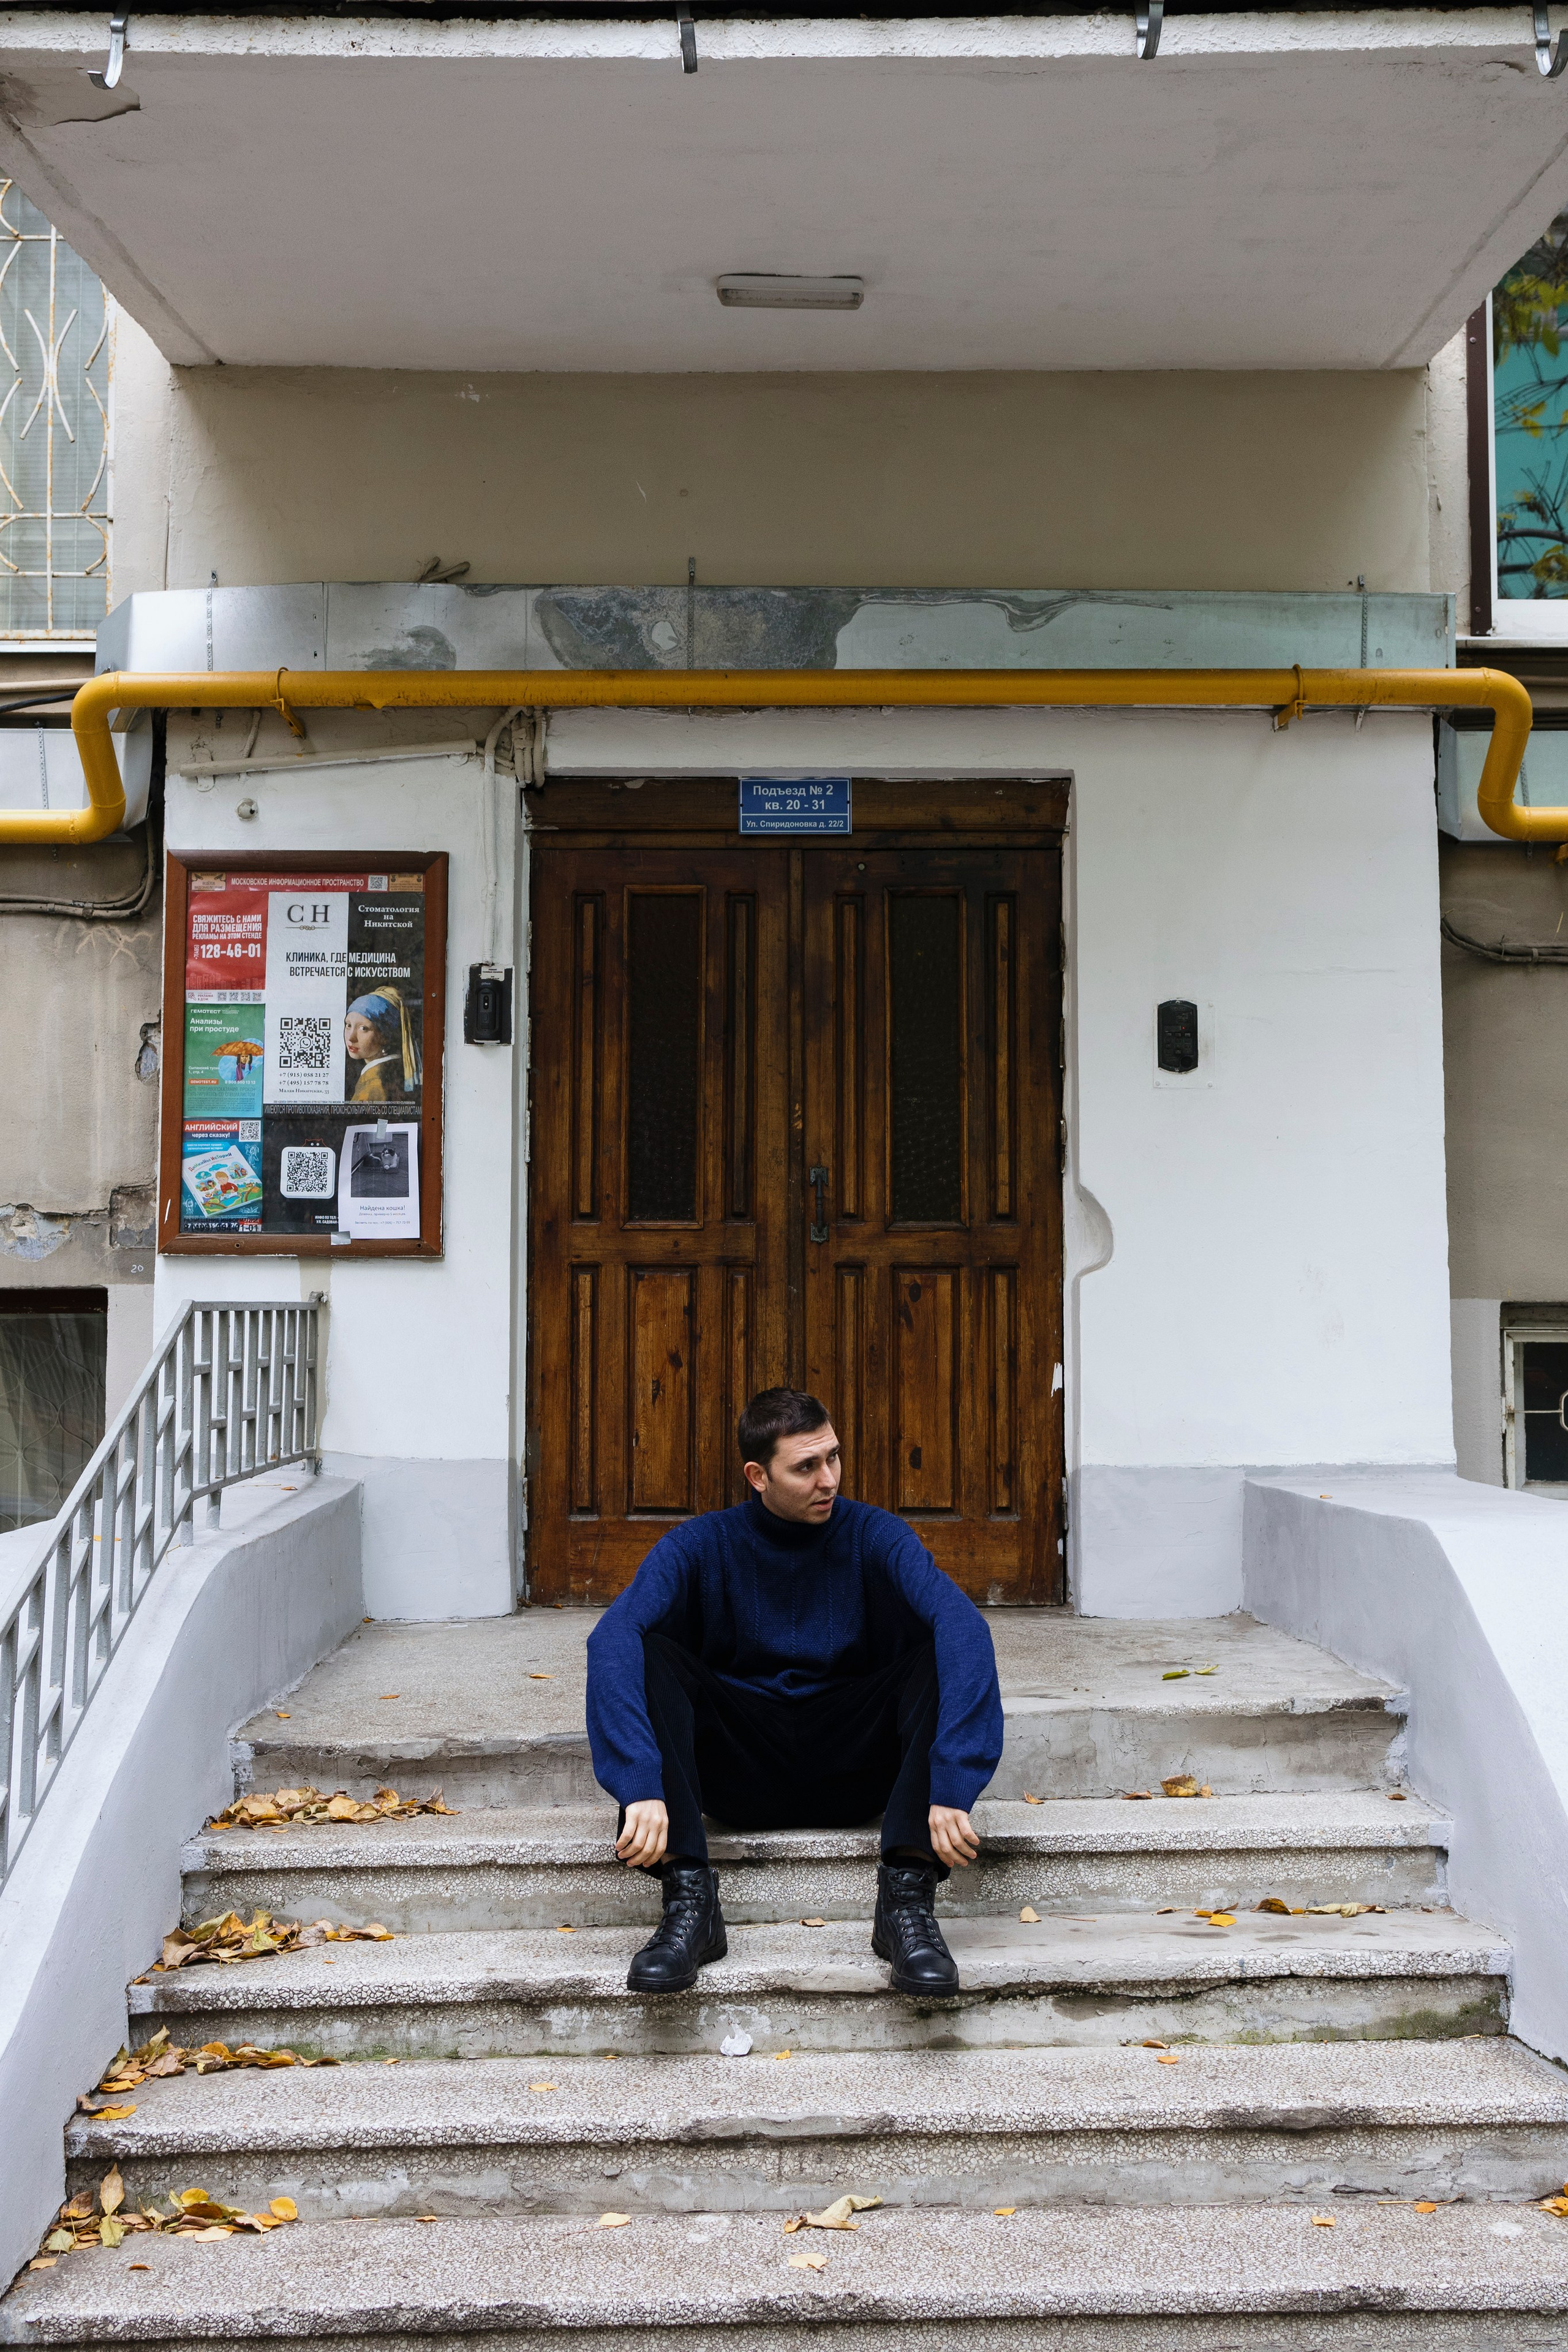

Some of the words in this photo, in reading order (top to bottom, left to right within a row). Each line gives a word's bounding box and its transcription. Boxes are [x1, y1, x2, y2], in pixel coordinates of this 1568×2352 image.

[753, 785, 806, 797] Подъезд
[809, 786, 823, 795] №
[826, 785, 833, 795] 2
[765, 801, 783, 810] кв.
[786, 800, 800, 810] 20
[812, 800, 825, 810] 31
[760, 820, 817, 829] Спиридоновка
[193, 915, 235, 923] СВЯЖИТЕСЬ
[236, 915, 241, 923] С
[243, 914, 262, 923] НАМИ
[192, 923, 208, 933] ДЛЯ
[210, 923, 262, 933] РАЗМЕЩЕНИЯ
[201, 943, 261, 958] 128-46-01
[286, 952, 328, 963] КЛИНИКА,
[330, 952, 346, 963] ГДЕ
[349, 953, 396, 964] МЕДИЦИНА
[290, 967, 345, 977] ВСТРЕЧАЕТСЯ
[348, 967, 353, 977] С
[355, 967, 410, 978] ИСКУССТВОМ
[264, 1105, 285, 1114] ИМЕЮТСЯ
[286, 1105, 330, 1115] ПРОТИВОПОКАЗАНИЯ,
[331, 1104, 381, 1114] ПРОКОНСУЛЬТИРУЙТЕСЬ
[381, 1106, 387, 1114] СО
[131, 1265, 144, 1273] 20
